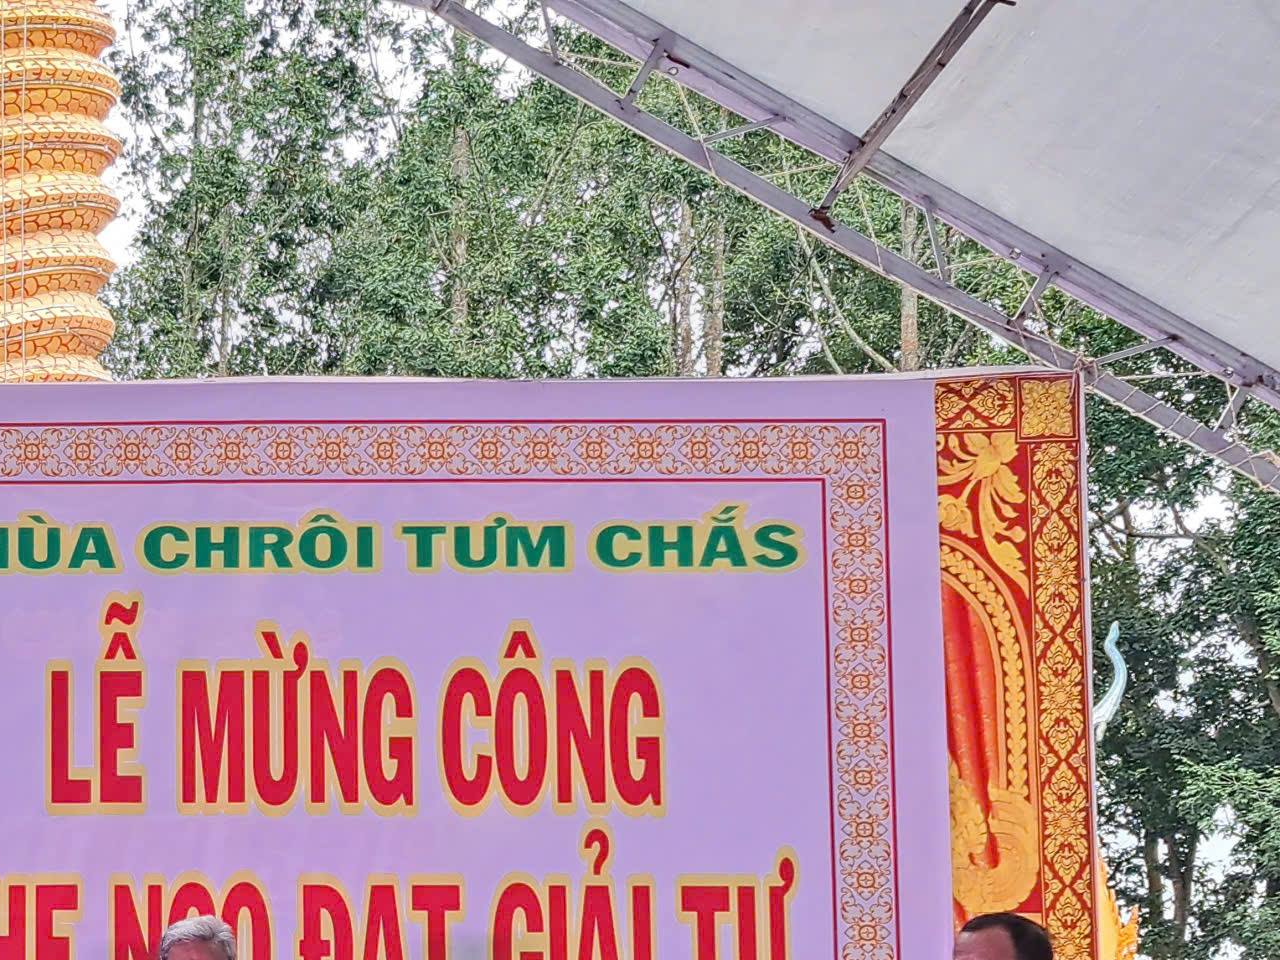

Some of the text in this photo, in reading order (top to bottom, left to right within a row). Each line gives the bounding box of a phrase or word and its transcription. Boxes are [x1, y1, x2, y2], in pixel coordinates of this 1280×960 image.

[143, 513, 373, 570] CHRÔI
[402, 516, 566, 569] TƯM
[595, 503, 799, 568] CHẮS
[50, 602, 662, 806] LỄ MỪNG CÔNG
